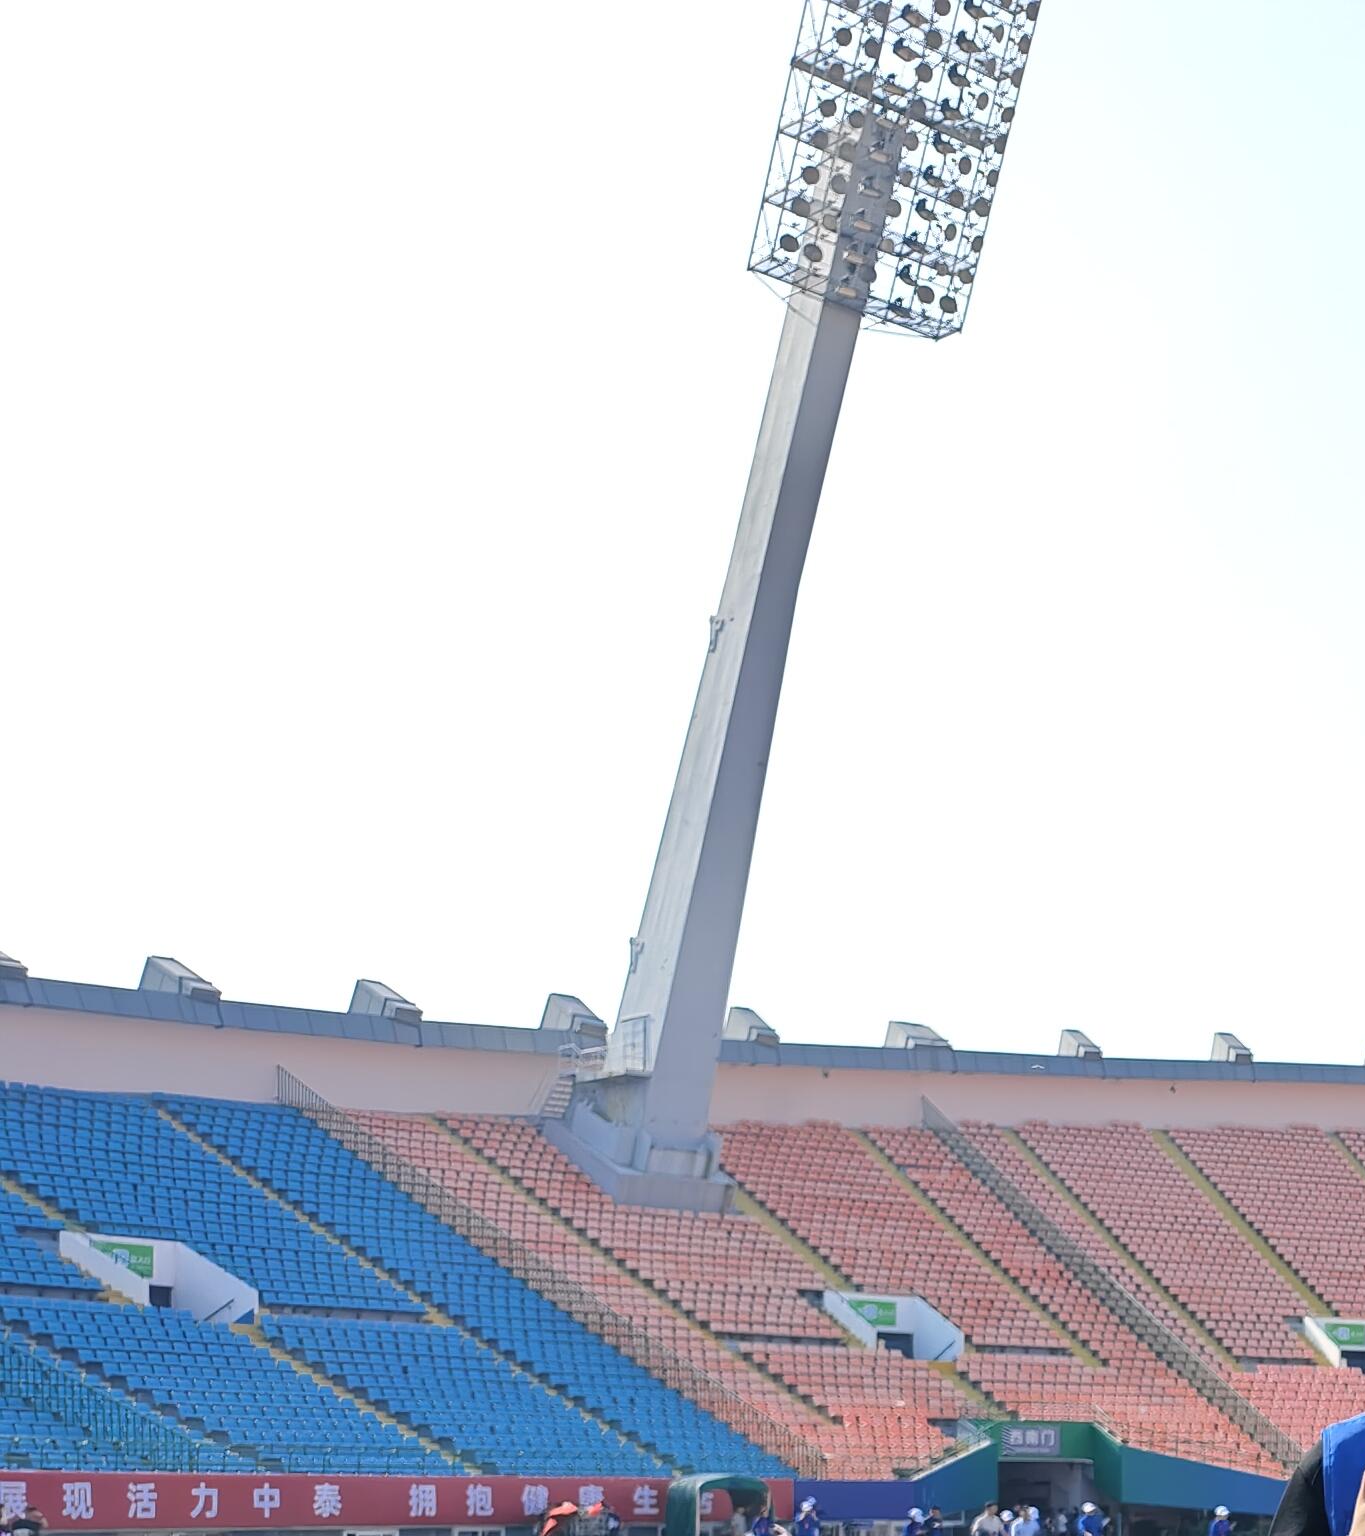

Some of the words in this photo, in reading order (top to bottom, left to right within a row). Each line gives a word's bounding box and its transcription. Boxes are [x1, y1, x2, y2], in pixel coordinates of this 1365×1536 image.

[0, 1481, 341, 1520] 展现活力中泰
